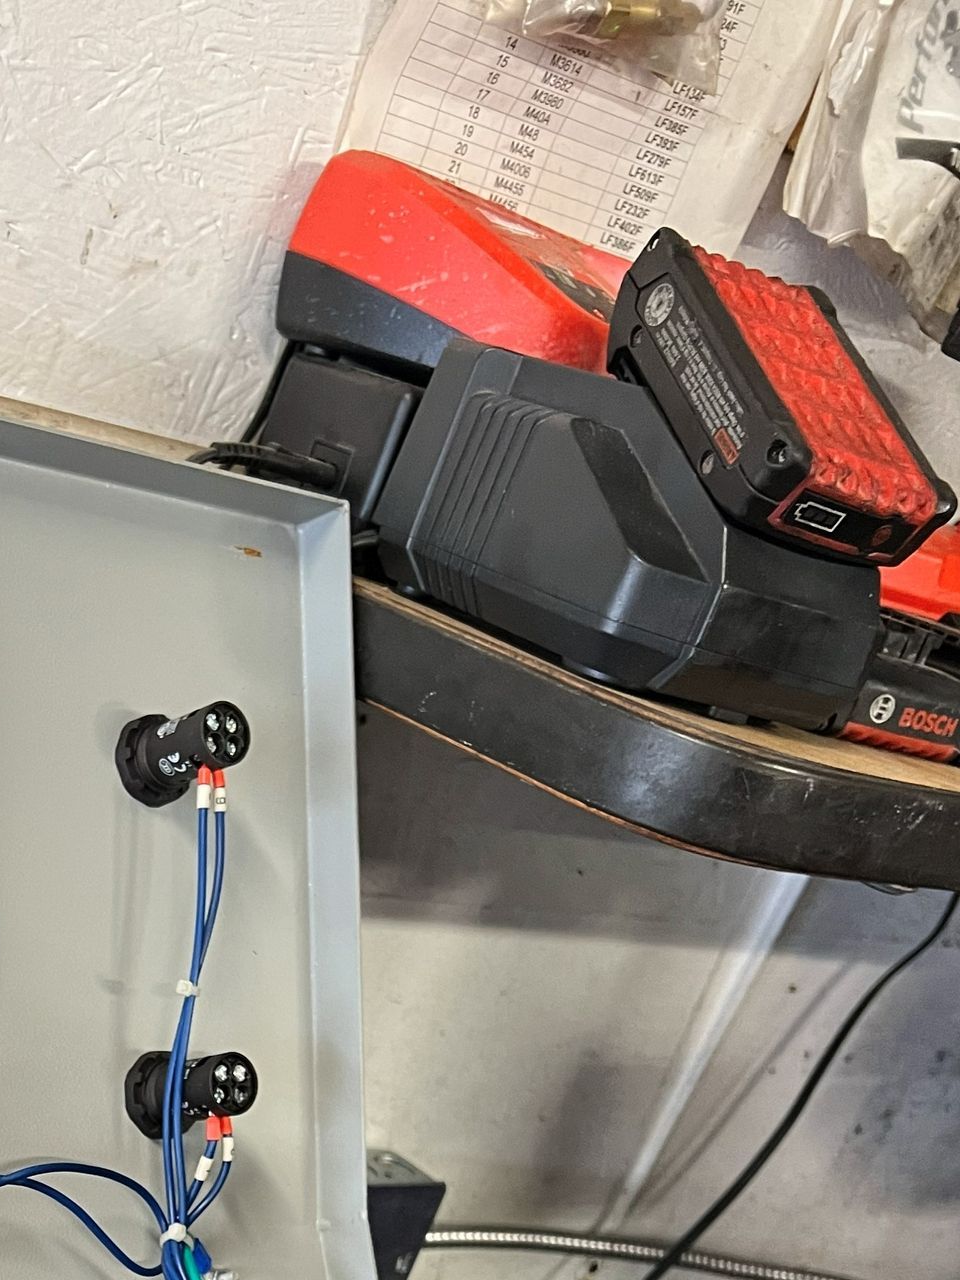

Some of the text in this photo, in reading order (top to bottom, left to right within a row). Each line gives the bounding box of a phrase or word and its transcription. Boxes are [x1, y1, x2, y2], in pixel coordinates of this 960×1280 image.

[476, 88, 490, 101] 17
[486, 71, 500, 85] 16
[496, 54, 510, 68] 15
[654, 116, 689, 136] LF385F
[505, 35, 699, 120] 14 M3614 LF157F
[462, 123, 474, 138] 19
[509, 141, 536, 160] M454
[468, 105, 481, 119] 18
[518, 124, 540, 142] M48
[454, 142, 468, 157] 20
[448, 160, 461, 175] 21
[494, 175, 526, 197] M4455
[898, 706, 959, 738] BOSCH
